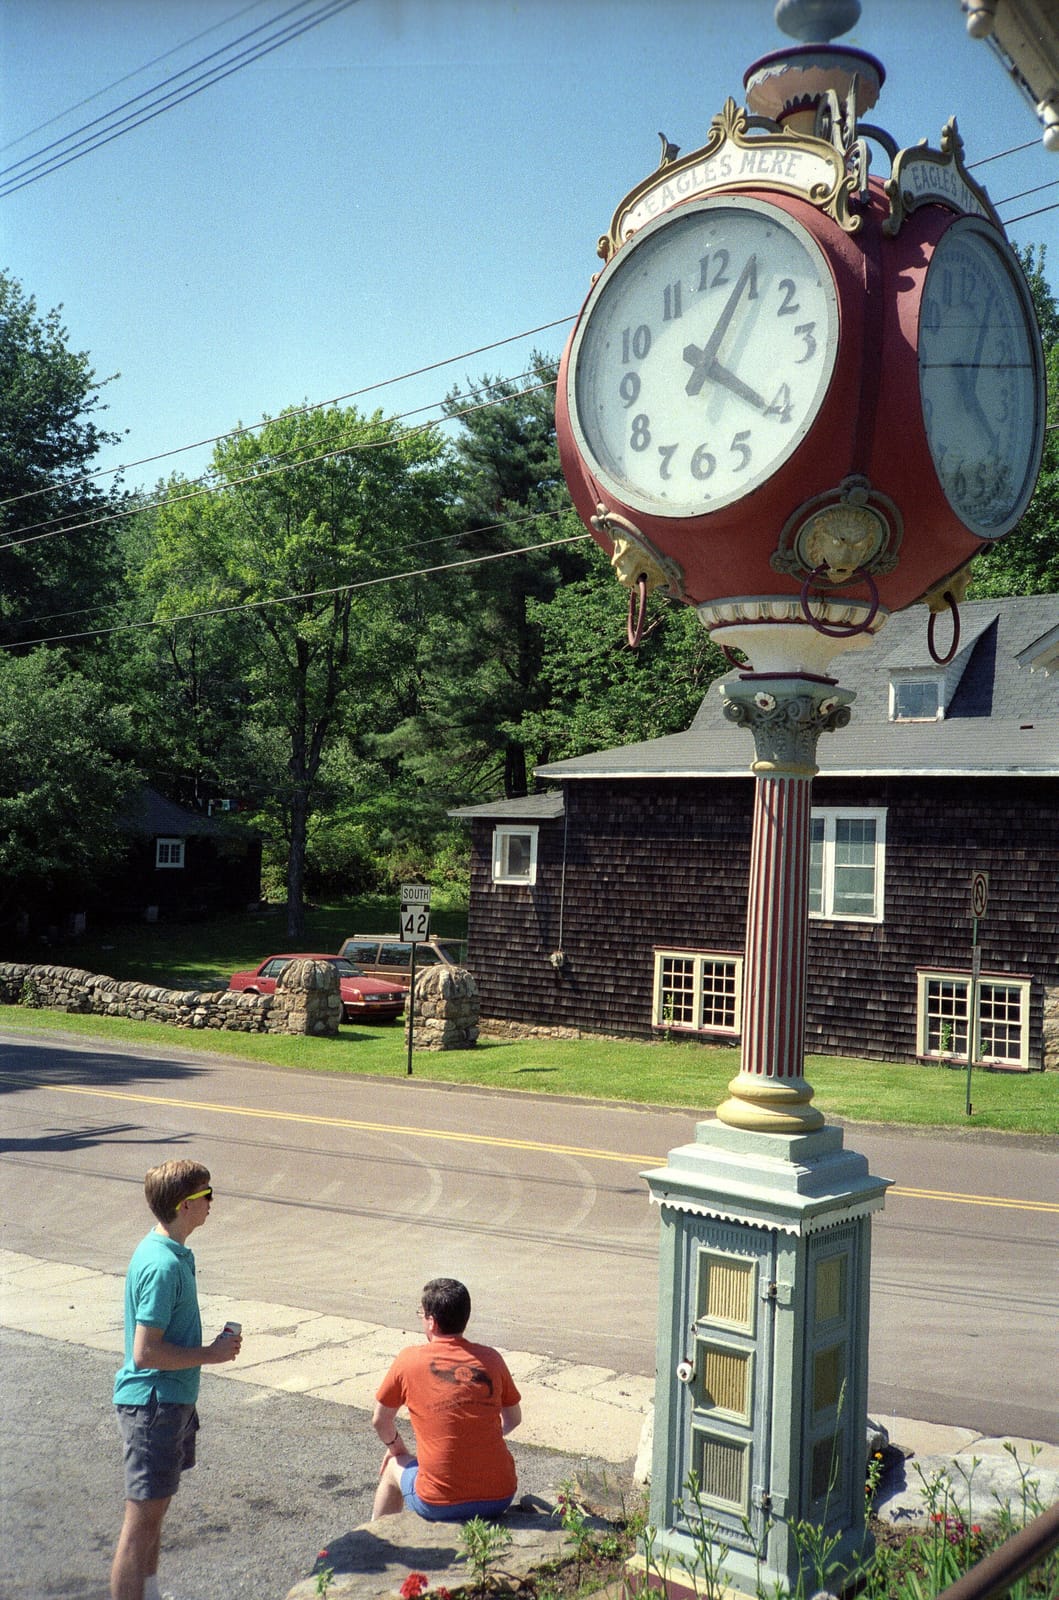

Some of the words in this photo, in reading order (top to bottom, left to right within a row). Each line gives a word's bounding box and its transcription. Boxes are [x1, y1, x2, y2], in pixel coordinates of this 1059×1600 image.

[643, 157, 732, 215] EAGLES
[738, 150, 803, 179] MERE
[912, 165, 957, 197] EAGLES
[698, 249, 730, 292] 12
[663, 280, 682, 322] 11
[777, 278, 799, 317] 2
[622, 324, 651, 364] 10
[794, 321, 817, 364] 3
[619, 372, 641, 408] 9
[763, 382, 794, 424] 4
[630, 414, 651, 452] 8
[730, 430, 752, 473] 5
[658, 442, 679, 480] 7
[690, 443, 717, 480] 6
[403, 888, 429, 900] SOUTH
[405, 914, 426, 934] 42
